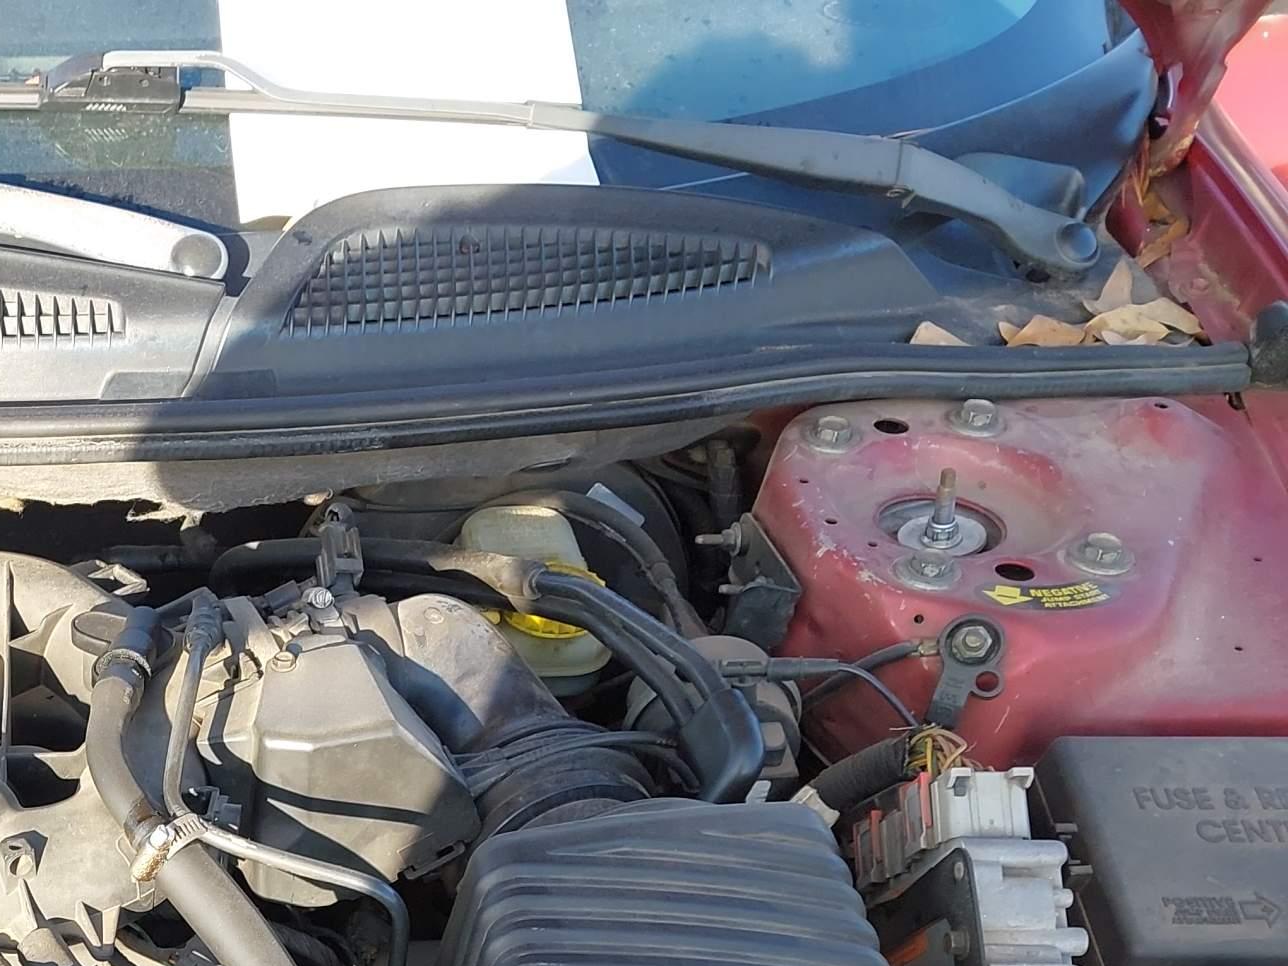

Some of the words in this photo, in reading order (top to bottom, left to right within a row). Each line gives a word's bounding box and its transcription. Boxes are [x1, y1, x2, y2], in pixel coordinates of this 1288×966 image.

[1029, 581, 1098, 597] NEGATIVE
[1132, 787, 1216, 811] FUSE
[1223, 787, 1250, 810] &
[1196, 819, 1288, 843] CENT
